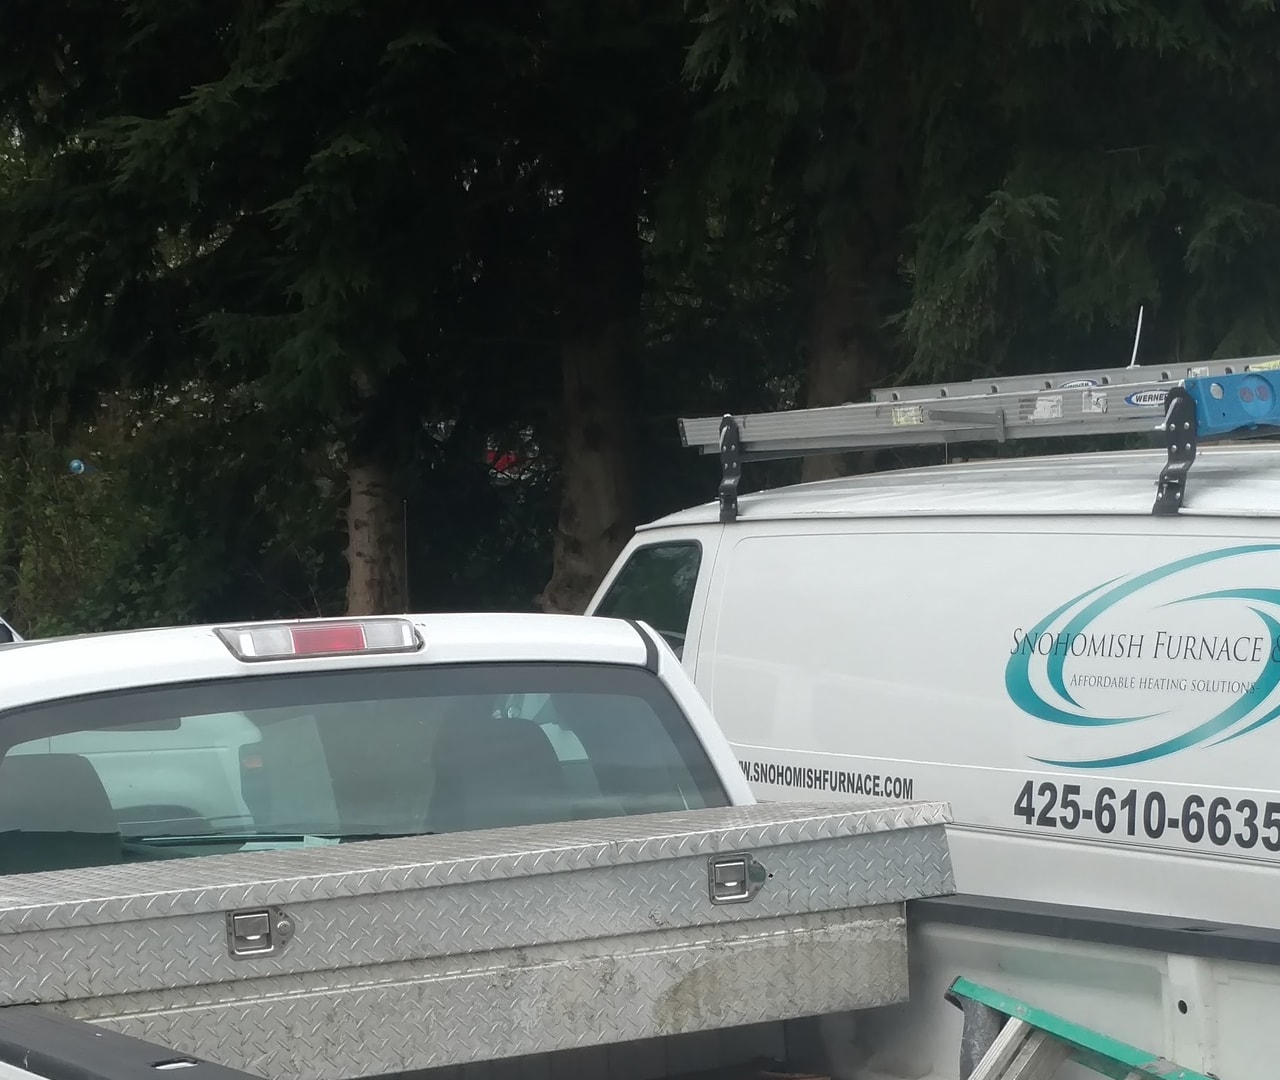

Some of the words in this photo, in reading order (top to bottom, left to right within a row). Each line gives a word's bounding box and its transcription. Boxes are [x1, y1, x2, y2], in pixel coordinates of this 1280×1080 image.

[1010, 627, 1145, 659] SNOHOMISH
[1153, 630, 1263, 663] FURNACE
[1138, 676, 1187, 691] HEATING
[738, 760, 913, 800] W.SNOHOMISHFURNACE.COM
